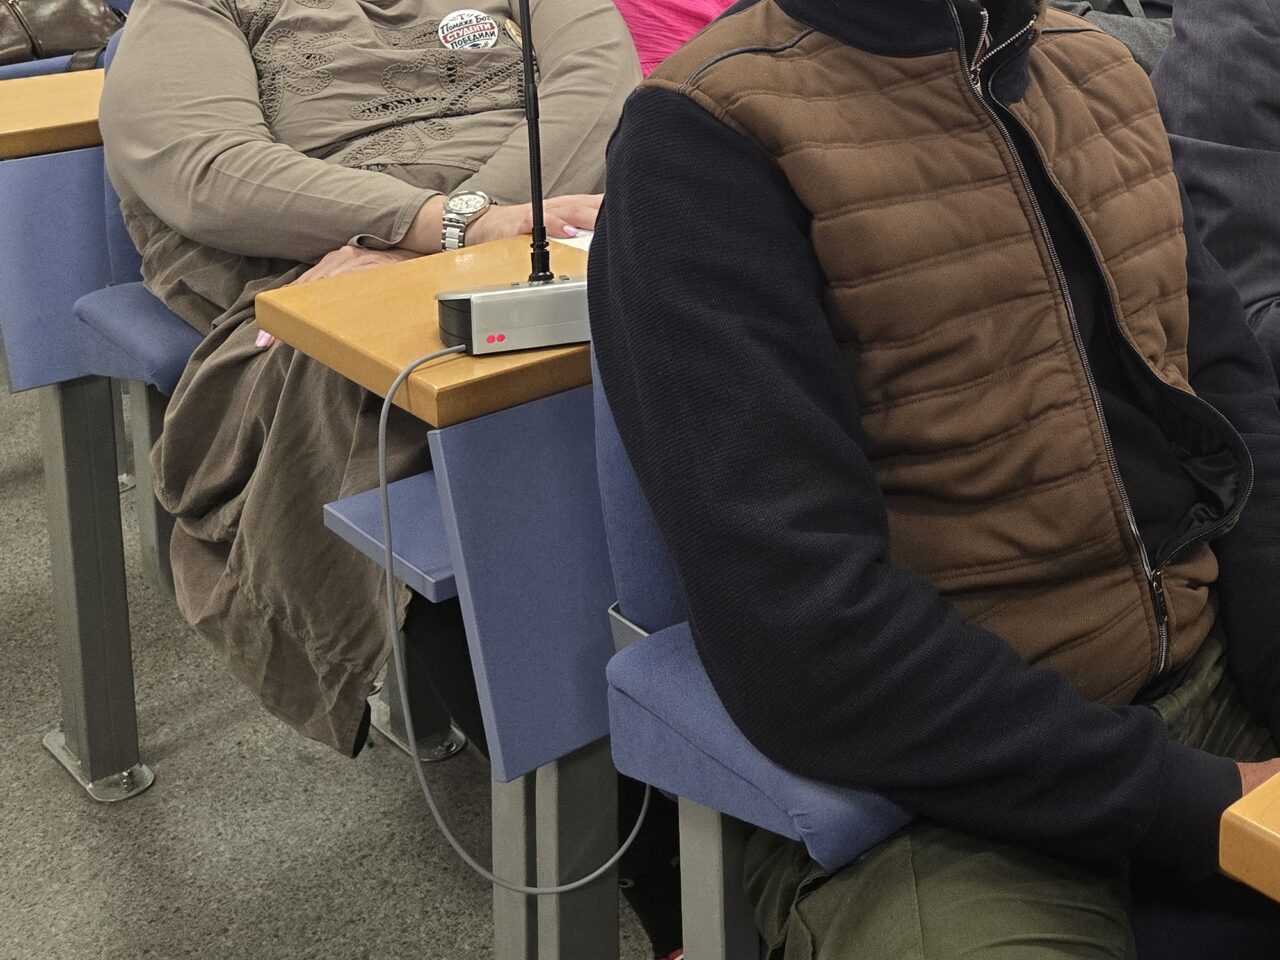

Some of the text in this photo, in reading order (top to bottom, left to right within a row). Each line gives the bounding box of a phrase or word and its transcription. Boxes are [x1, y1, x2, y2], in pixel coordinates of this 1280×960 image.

[440, 14, 491, 34] Помаже Бог
[446, 23, 491, 41] СТУДЕНТИ
[450, 31, 496, 49] ПОБЕДИЛИ
